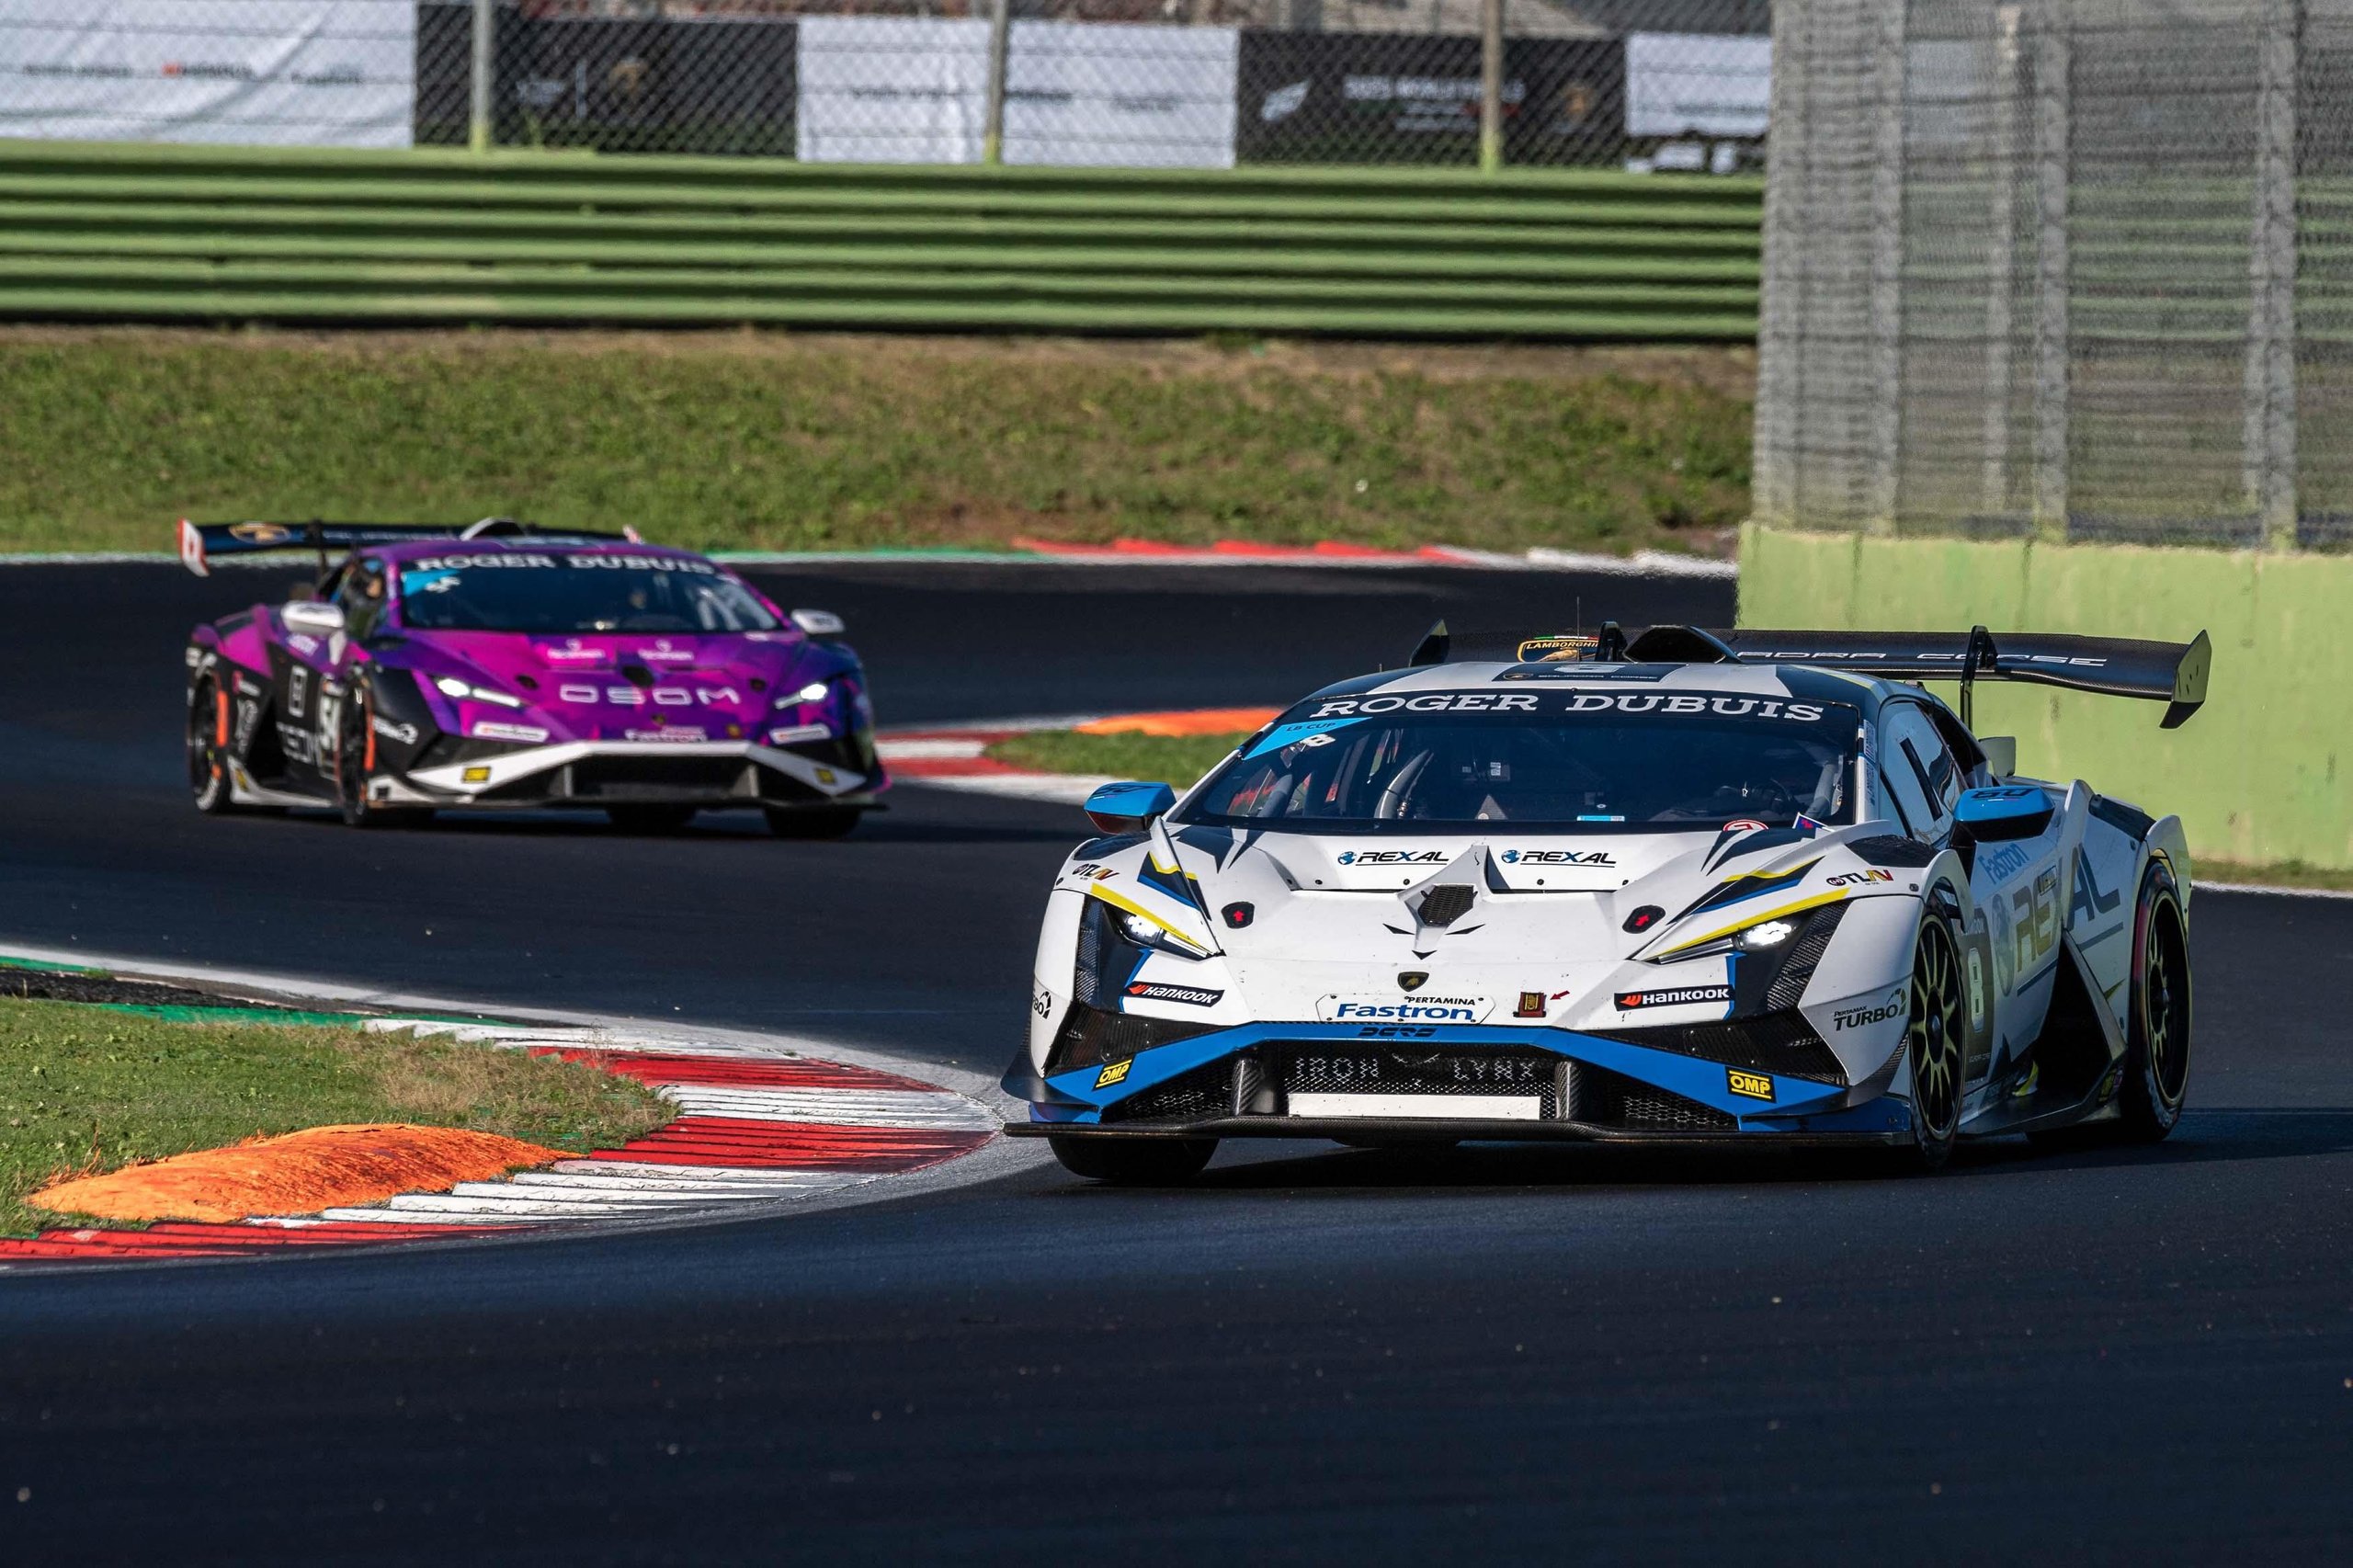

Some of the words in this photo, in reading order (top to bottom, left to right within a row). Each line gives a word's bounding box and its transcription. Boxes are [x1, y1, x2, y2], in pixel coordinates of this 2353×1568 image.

[416, 553, 555, 571] ROGER
[567, 554, 715, 574] DUBUIS
[1527, 642, 1598, 650] LAMBORGHI
[1737, 652, 1887, 660] ADRA
[1916, 653, 2108, 667] CRSE
[560, 684, 741, 705] OSOM
[1310, 694, 1539, 718] ROGER
[1564, 695, 1824, 722] DUBUIS
[1307, 722, 1337, 731] CUP
[1302, 734, 1336, 747] 8
[1358, 851, 1449, 863] REXAL
[1521, 851, 1617, 864] REXAL
[1977, 842, 2029, 884] Fastron
[1968, 947, 1984, 1032] 8
[1406, 996, 1476, 1006] PERTAMINA
[1336, 1003, 1473, 1020] Fastron
[1834, 1006, 1868, 1017] PERTAMAX
[1834, 1004, 1898, 1031] TURBO
[1099, 1063, 1130, 1084] OMP
[1730, 1074, 1771, 1095] OMP
